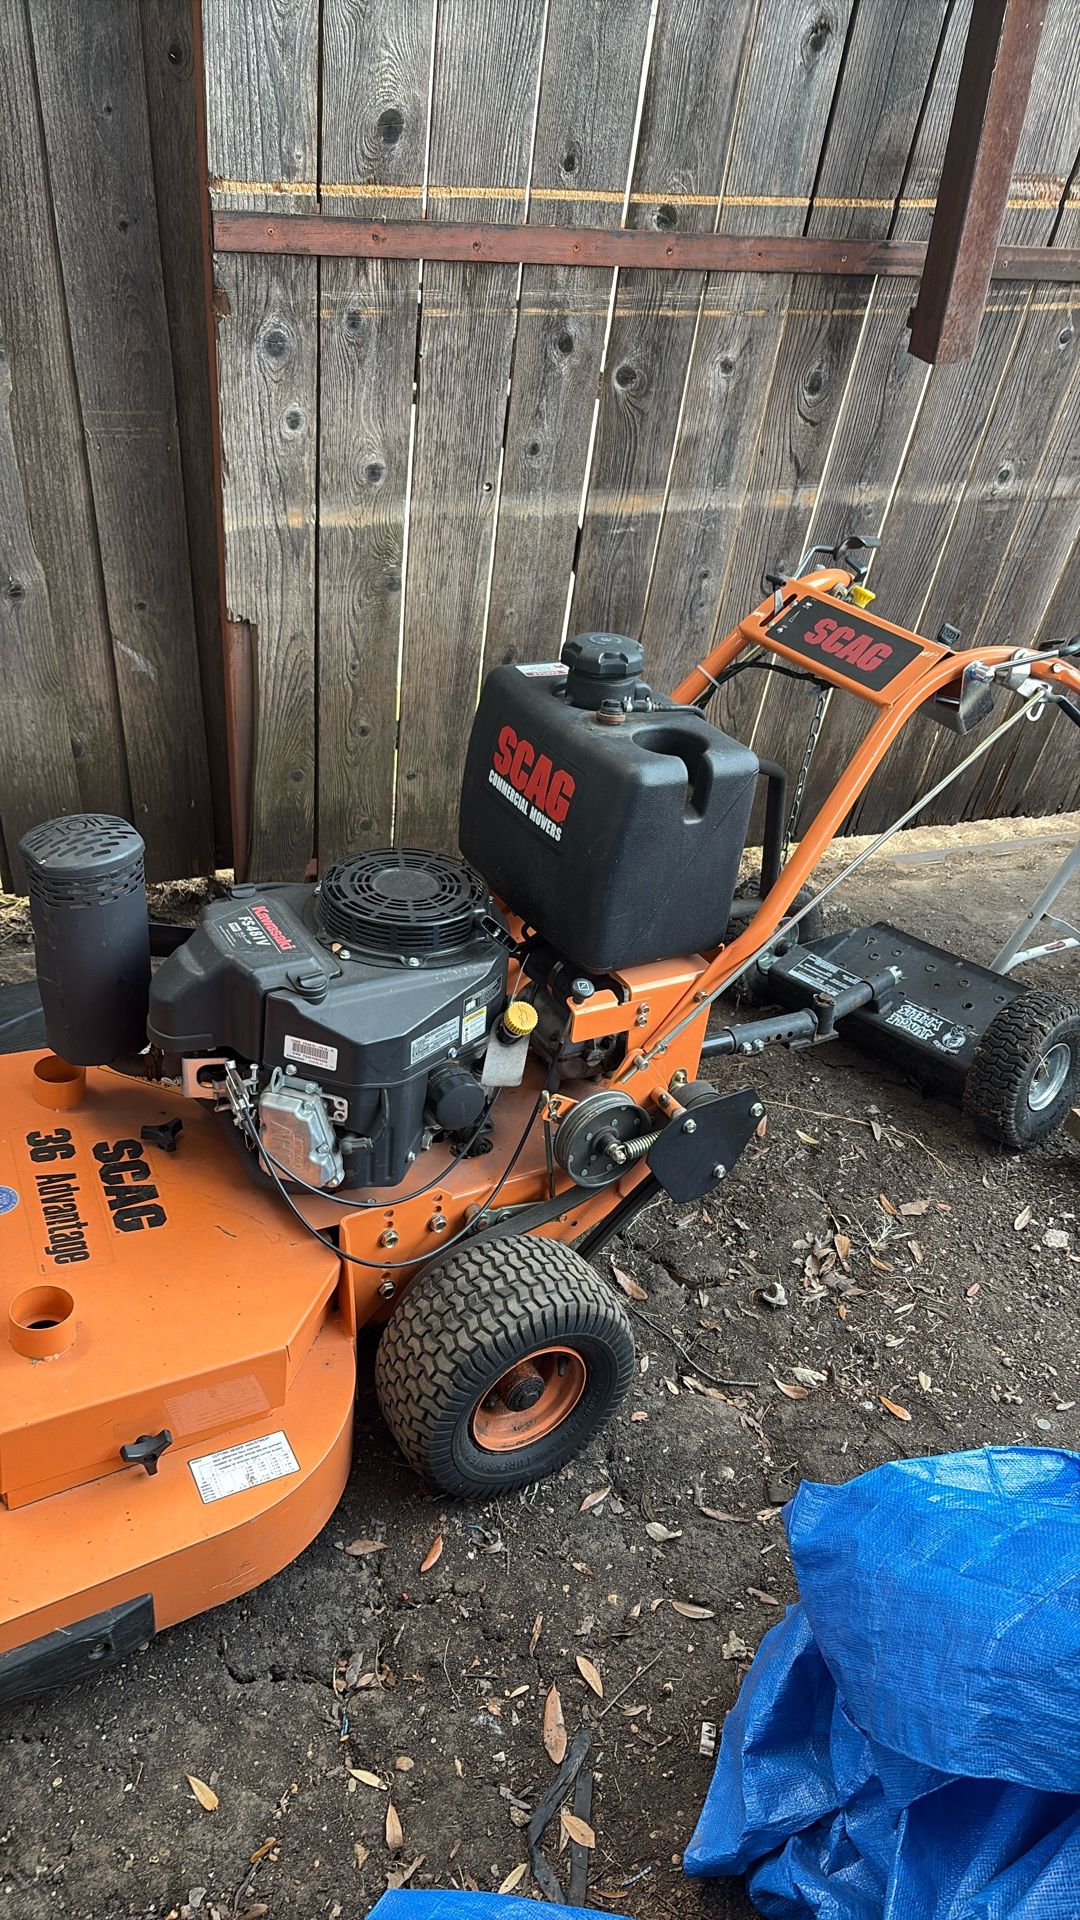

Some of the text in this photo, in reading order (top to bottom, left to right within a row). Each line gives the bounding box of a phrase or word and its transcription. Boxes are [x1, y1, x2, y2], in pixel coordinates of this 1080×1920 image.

[803, 618, 893, 671] SCAG
[493, 725, 576, 823] SCAG
[488, 769, 562, 842] COMMERCIAL MOWERS
[238, 916, 271, 946] FS481V
[252, 906, 296, 950] Kawasaki
[885, 1012, 935, 1040] JUNGLE
[896, 1004, 943, 1032] WHEELS
[26, 1128, 90, 1264] 36 Advantage
[92, 1139, 167, 1232] SCAG
